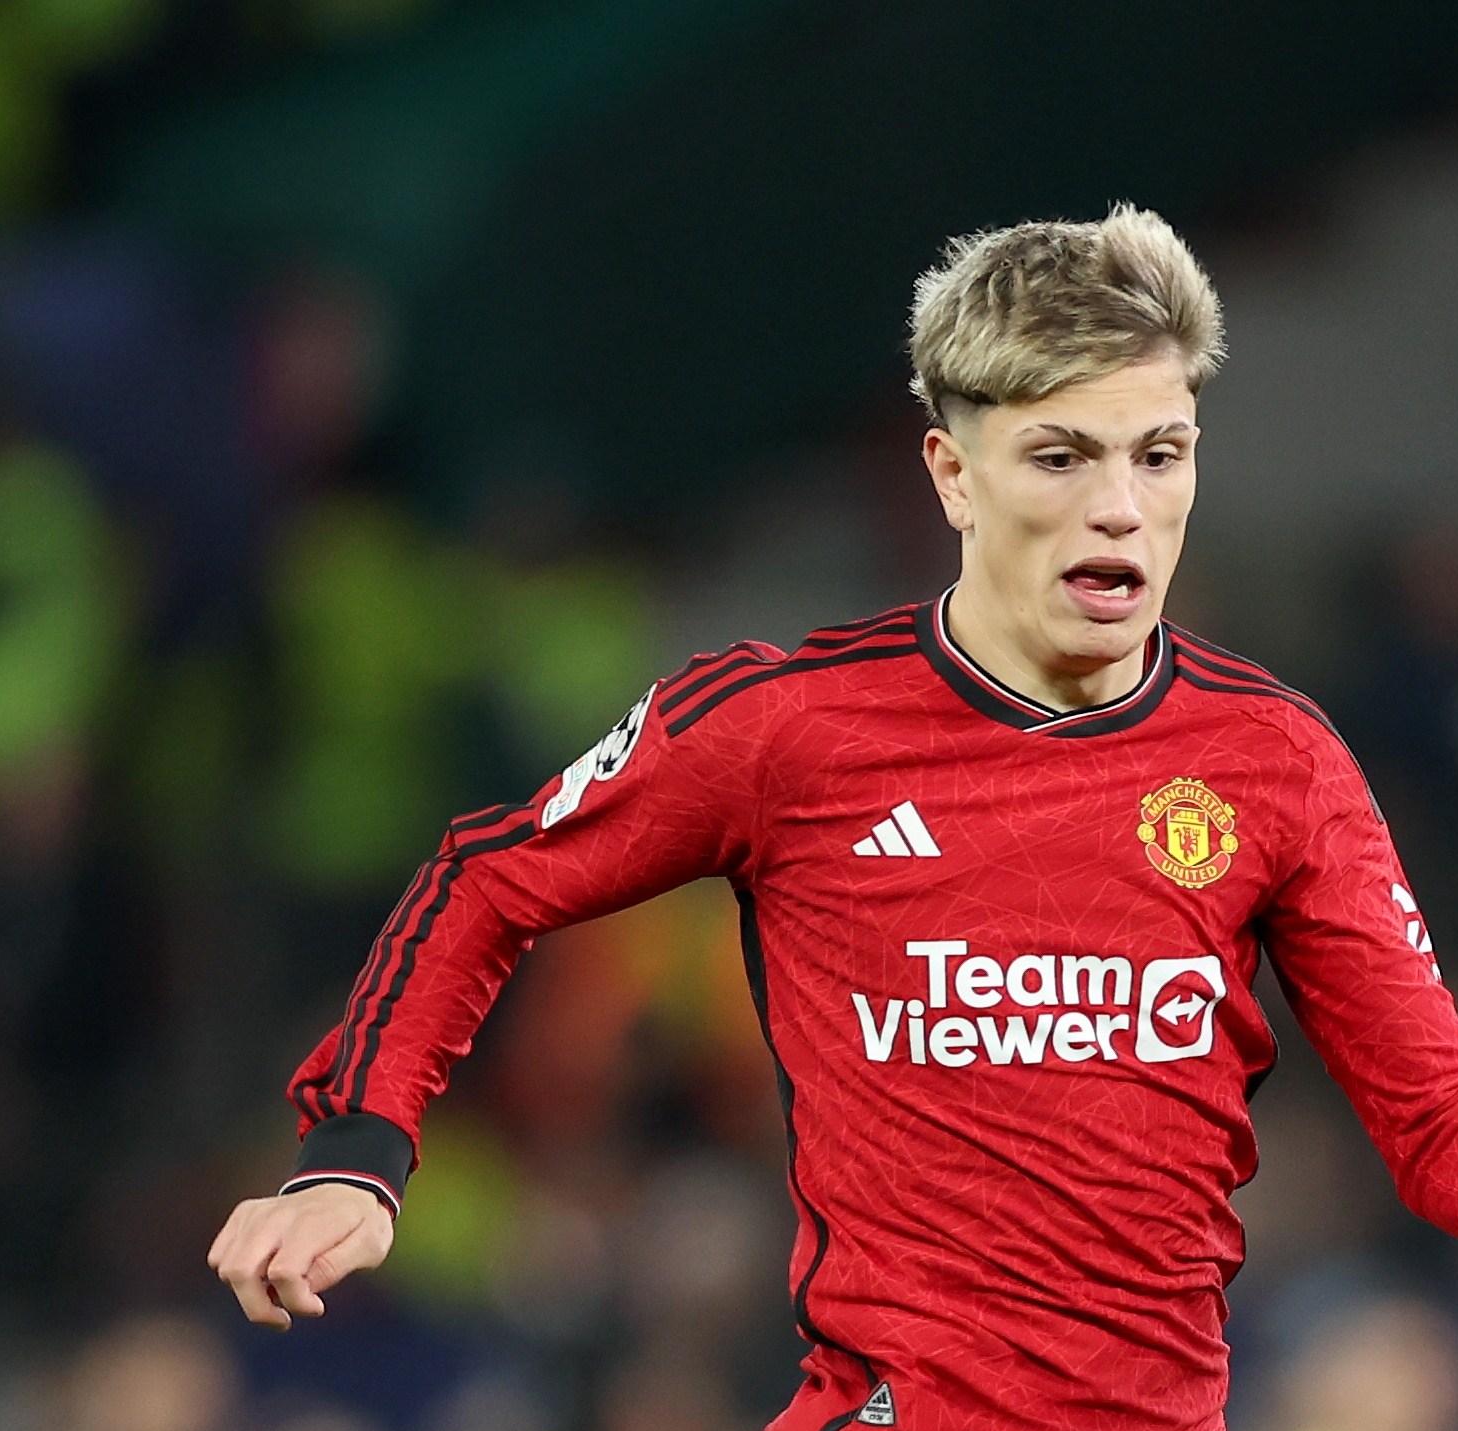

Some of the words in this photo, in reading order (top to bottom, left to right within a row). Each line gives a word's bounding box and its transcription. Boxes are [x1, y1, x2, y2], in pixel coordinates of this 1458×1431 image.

[1147, 785, 1229, 827] MANCHESTER
[1161, 859, 1218, 881] UNITED
[906, 940, 1133, 1008] Team
[852, 993, 1130, 1067] Viewer
